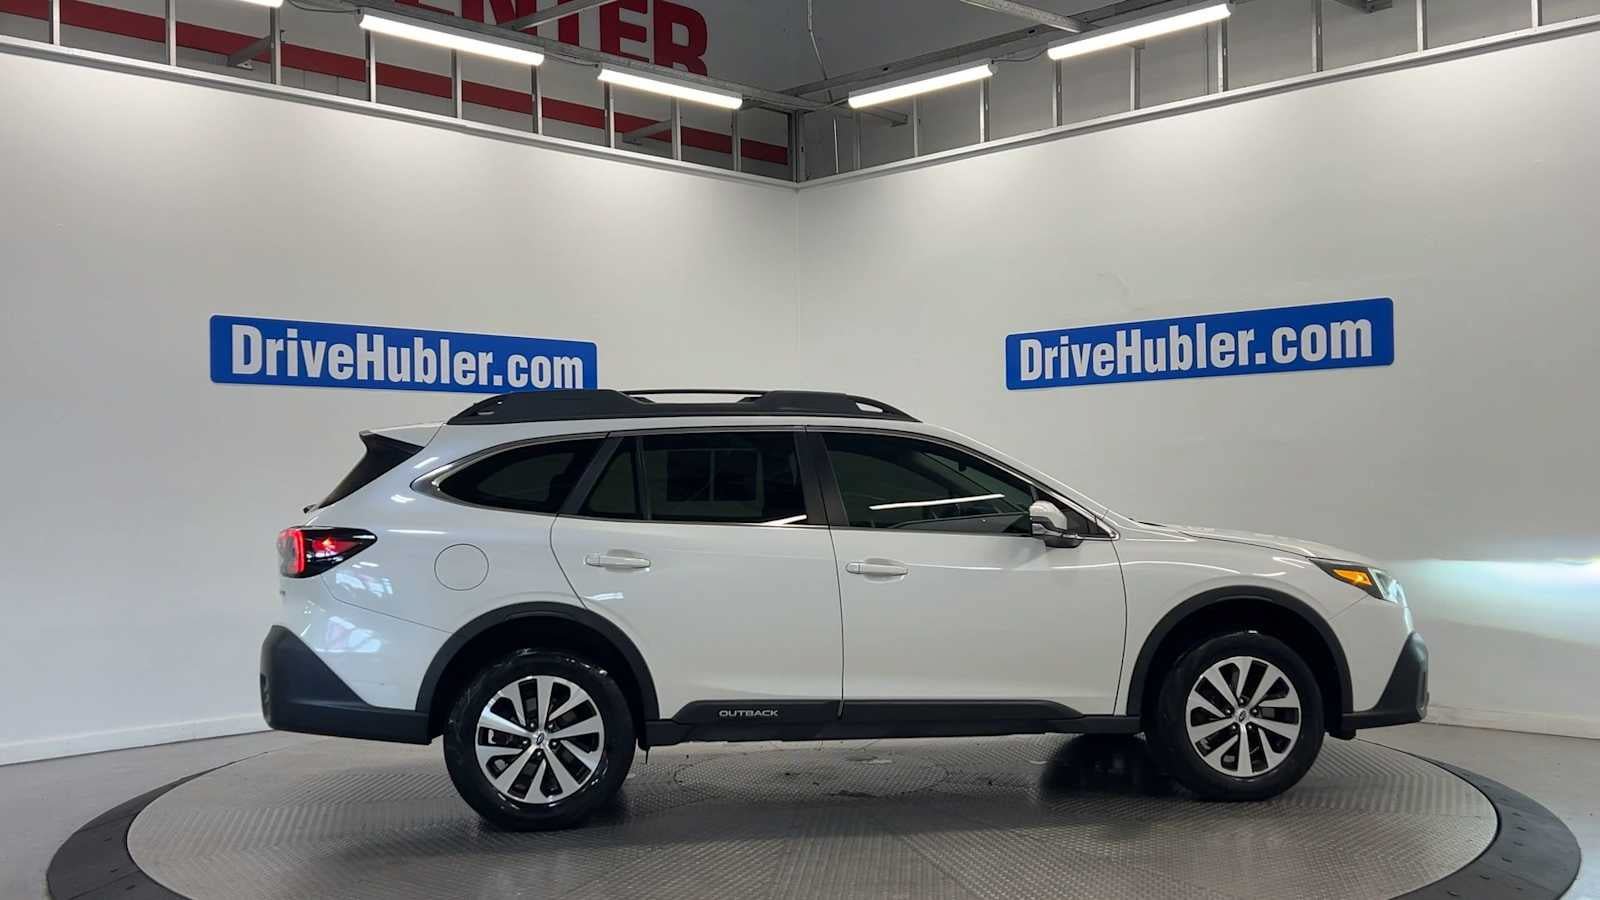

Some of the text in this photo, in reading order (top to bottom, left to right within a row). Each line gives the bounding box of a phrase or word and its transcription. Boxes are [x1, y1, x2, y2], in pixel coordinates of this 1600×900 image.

[231, 323, 584, 390] DriveHubler.com
[1019, 318, 1373, 382] DriveHubler.com
[719, 709, 779, 717] OUTBACK
